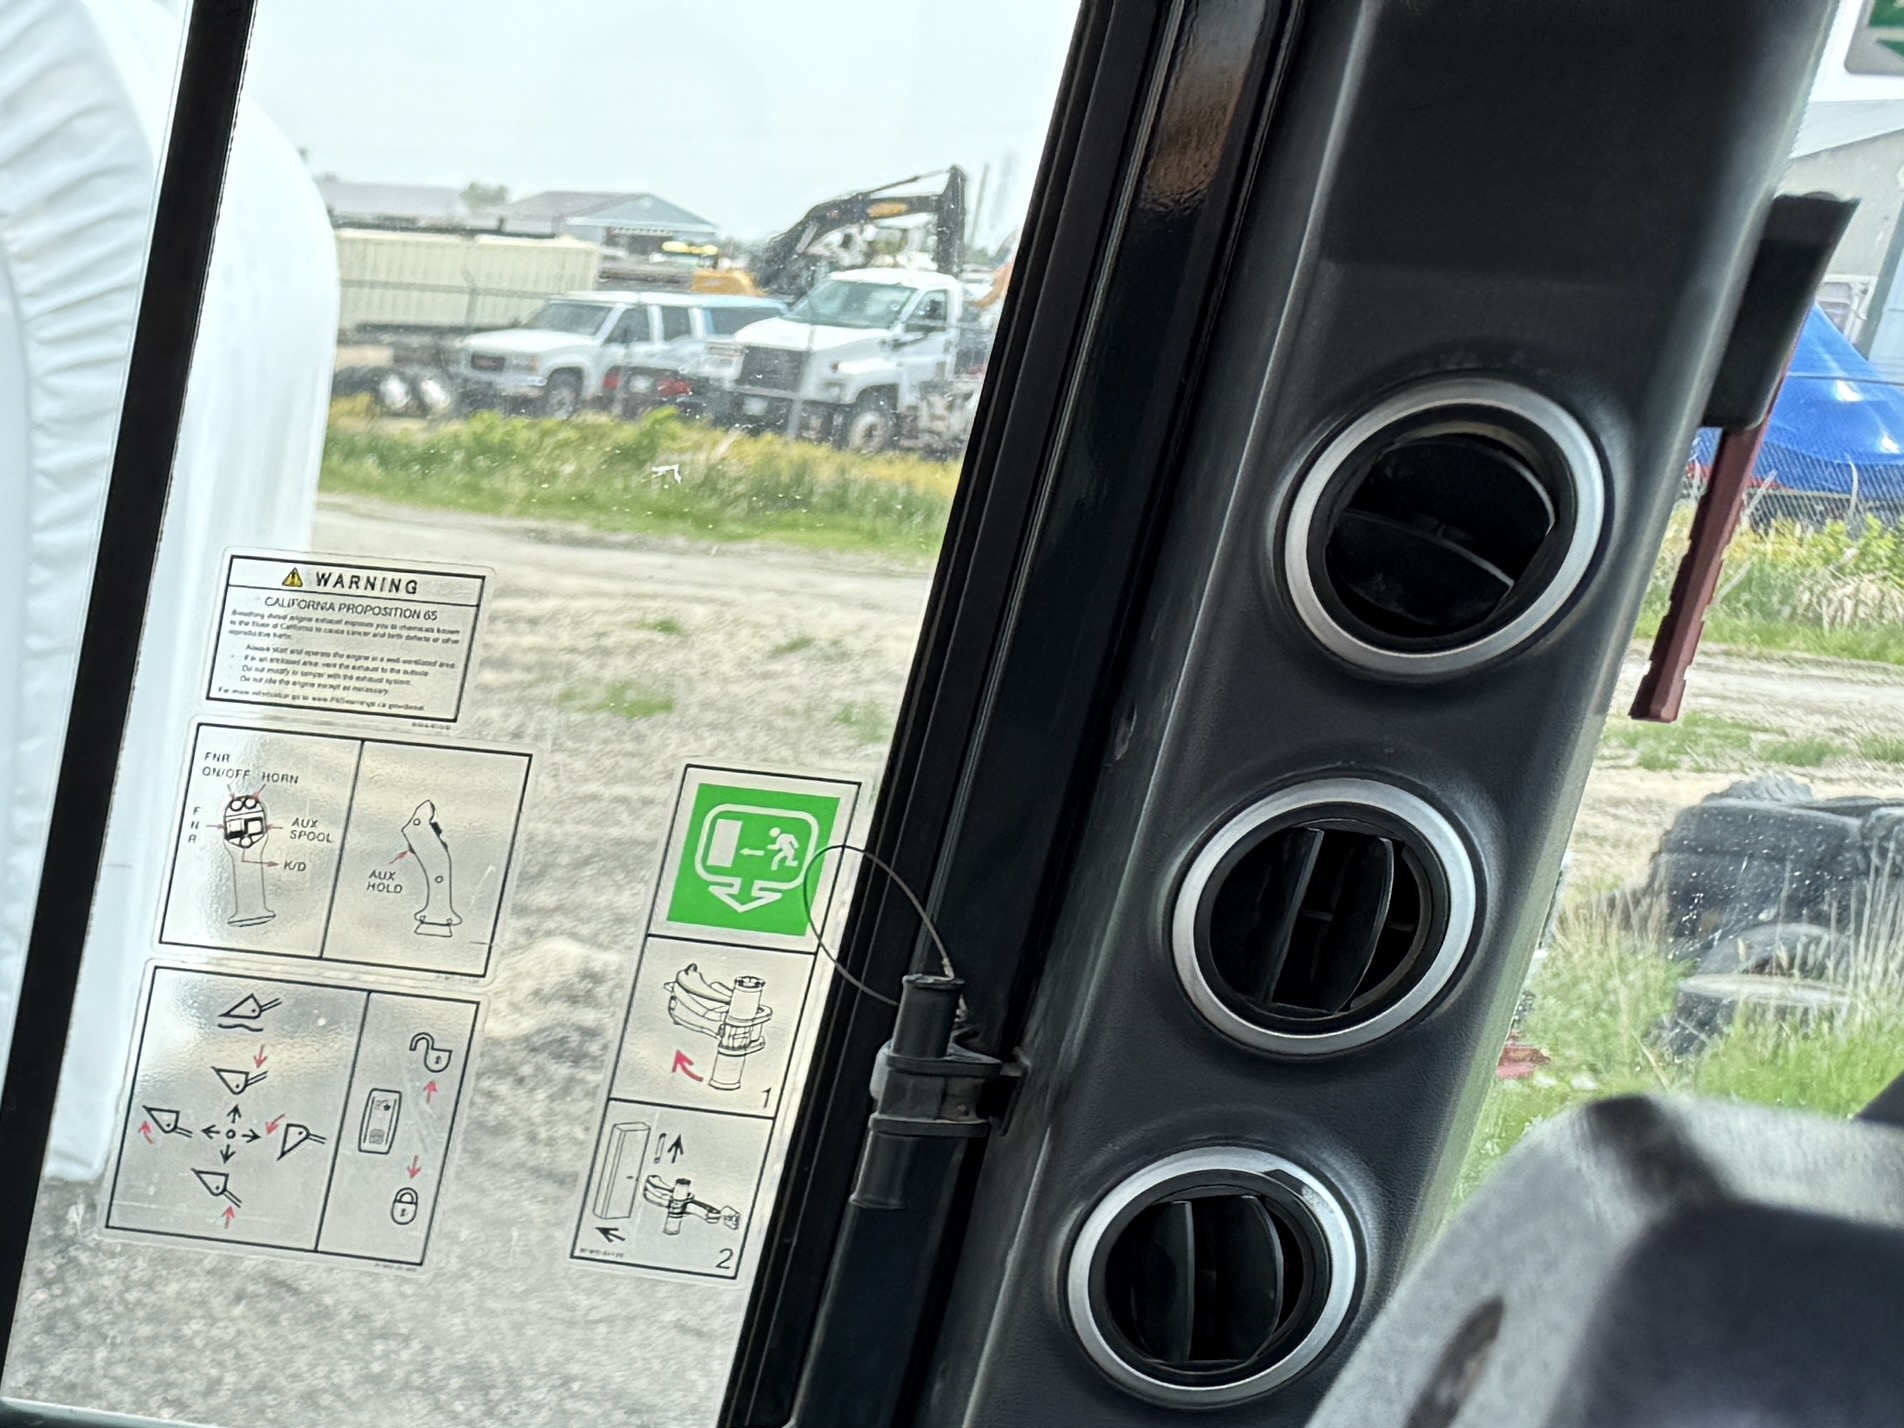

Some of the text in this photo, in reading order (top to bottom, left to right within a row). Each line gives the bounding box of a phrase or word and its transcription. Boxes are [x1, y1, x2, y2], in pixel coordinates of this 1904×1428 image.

[314, 571, 419, 593] WARNING
[264, 596, 438, 620] CALIFORNIA PROPOSITION 65
[204, 752, 231, 763] FNR
[262, 771, 299, 785] HORN
[291, 817, 319, 829] AUX
[290, 830, 333, 843] SPOOL
[369, 870, 396, 881] AUX
[366, 882, 403, 894] HOLD
[761, 1087, 772, 1108] 1
[716, 1248, 734, 1269] 2
